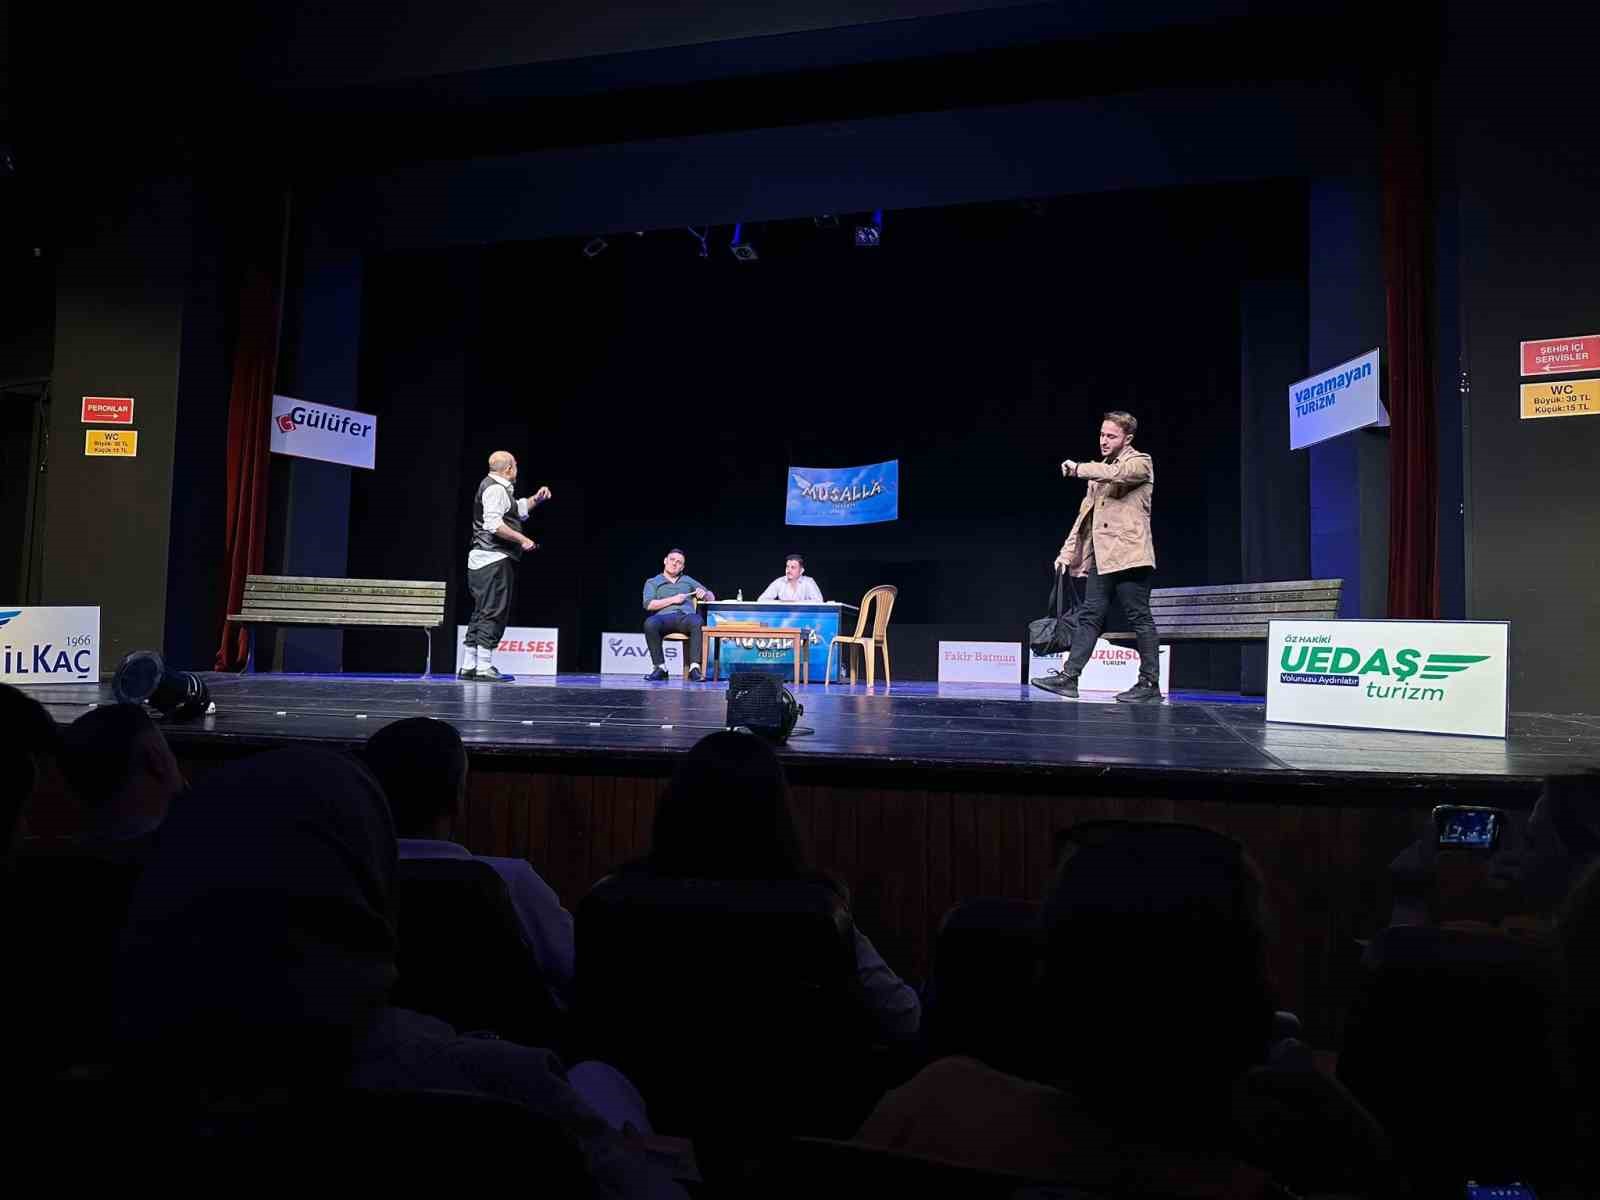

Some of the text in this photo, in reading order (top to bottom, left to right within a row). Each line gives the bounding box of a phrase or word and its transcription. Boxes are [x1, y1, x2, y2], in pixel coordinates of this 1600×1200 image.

[1295, 362, 1372, 402] varamayan
[1551, 384, 1573, 395] WC
[87, 404, 129, 413] PERONLAR
[1295, 393, 1336, 418] TURİZM
[291, 406, 371, 437] Gülüfer
[104, 432, 119, 441] WC
[67, 635, 91, 647] 1966
[1284, 634, 1298, 643] ÖZ
[610, 646, 678, 661] YAVŞ
[1281, 645, 1421, 682] UEDAŞ
[1281, 672, 1358, 686] Yolunuzu Aydınlatır
[1366, 681, 1445, 701] turizm
